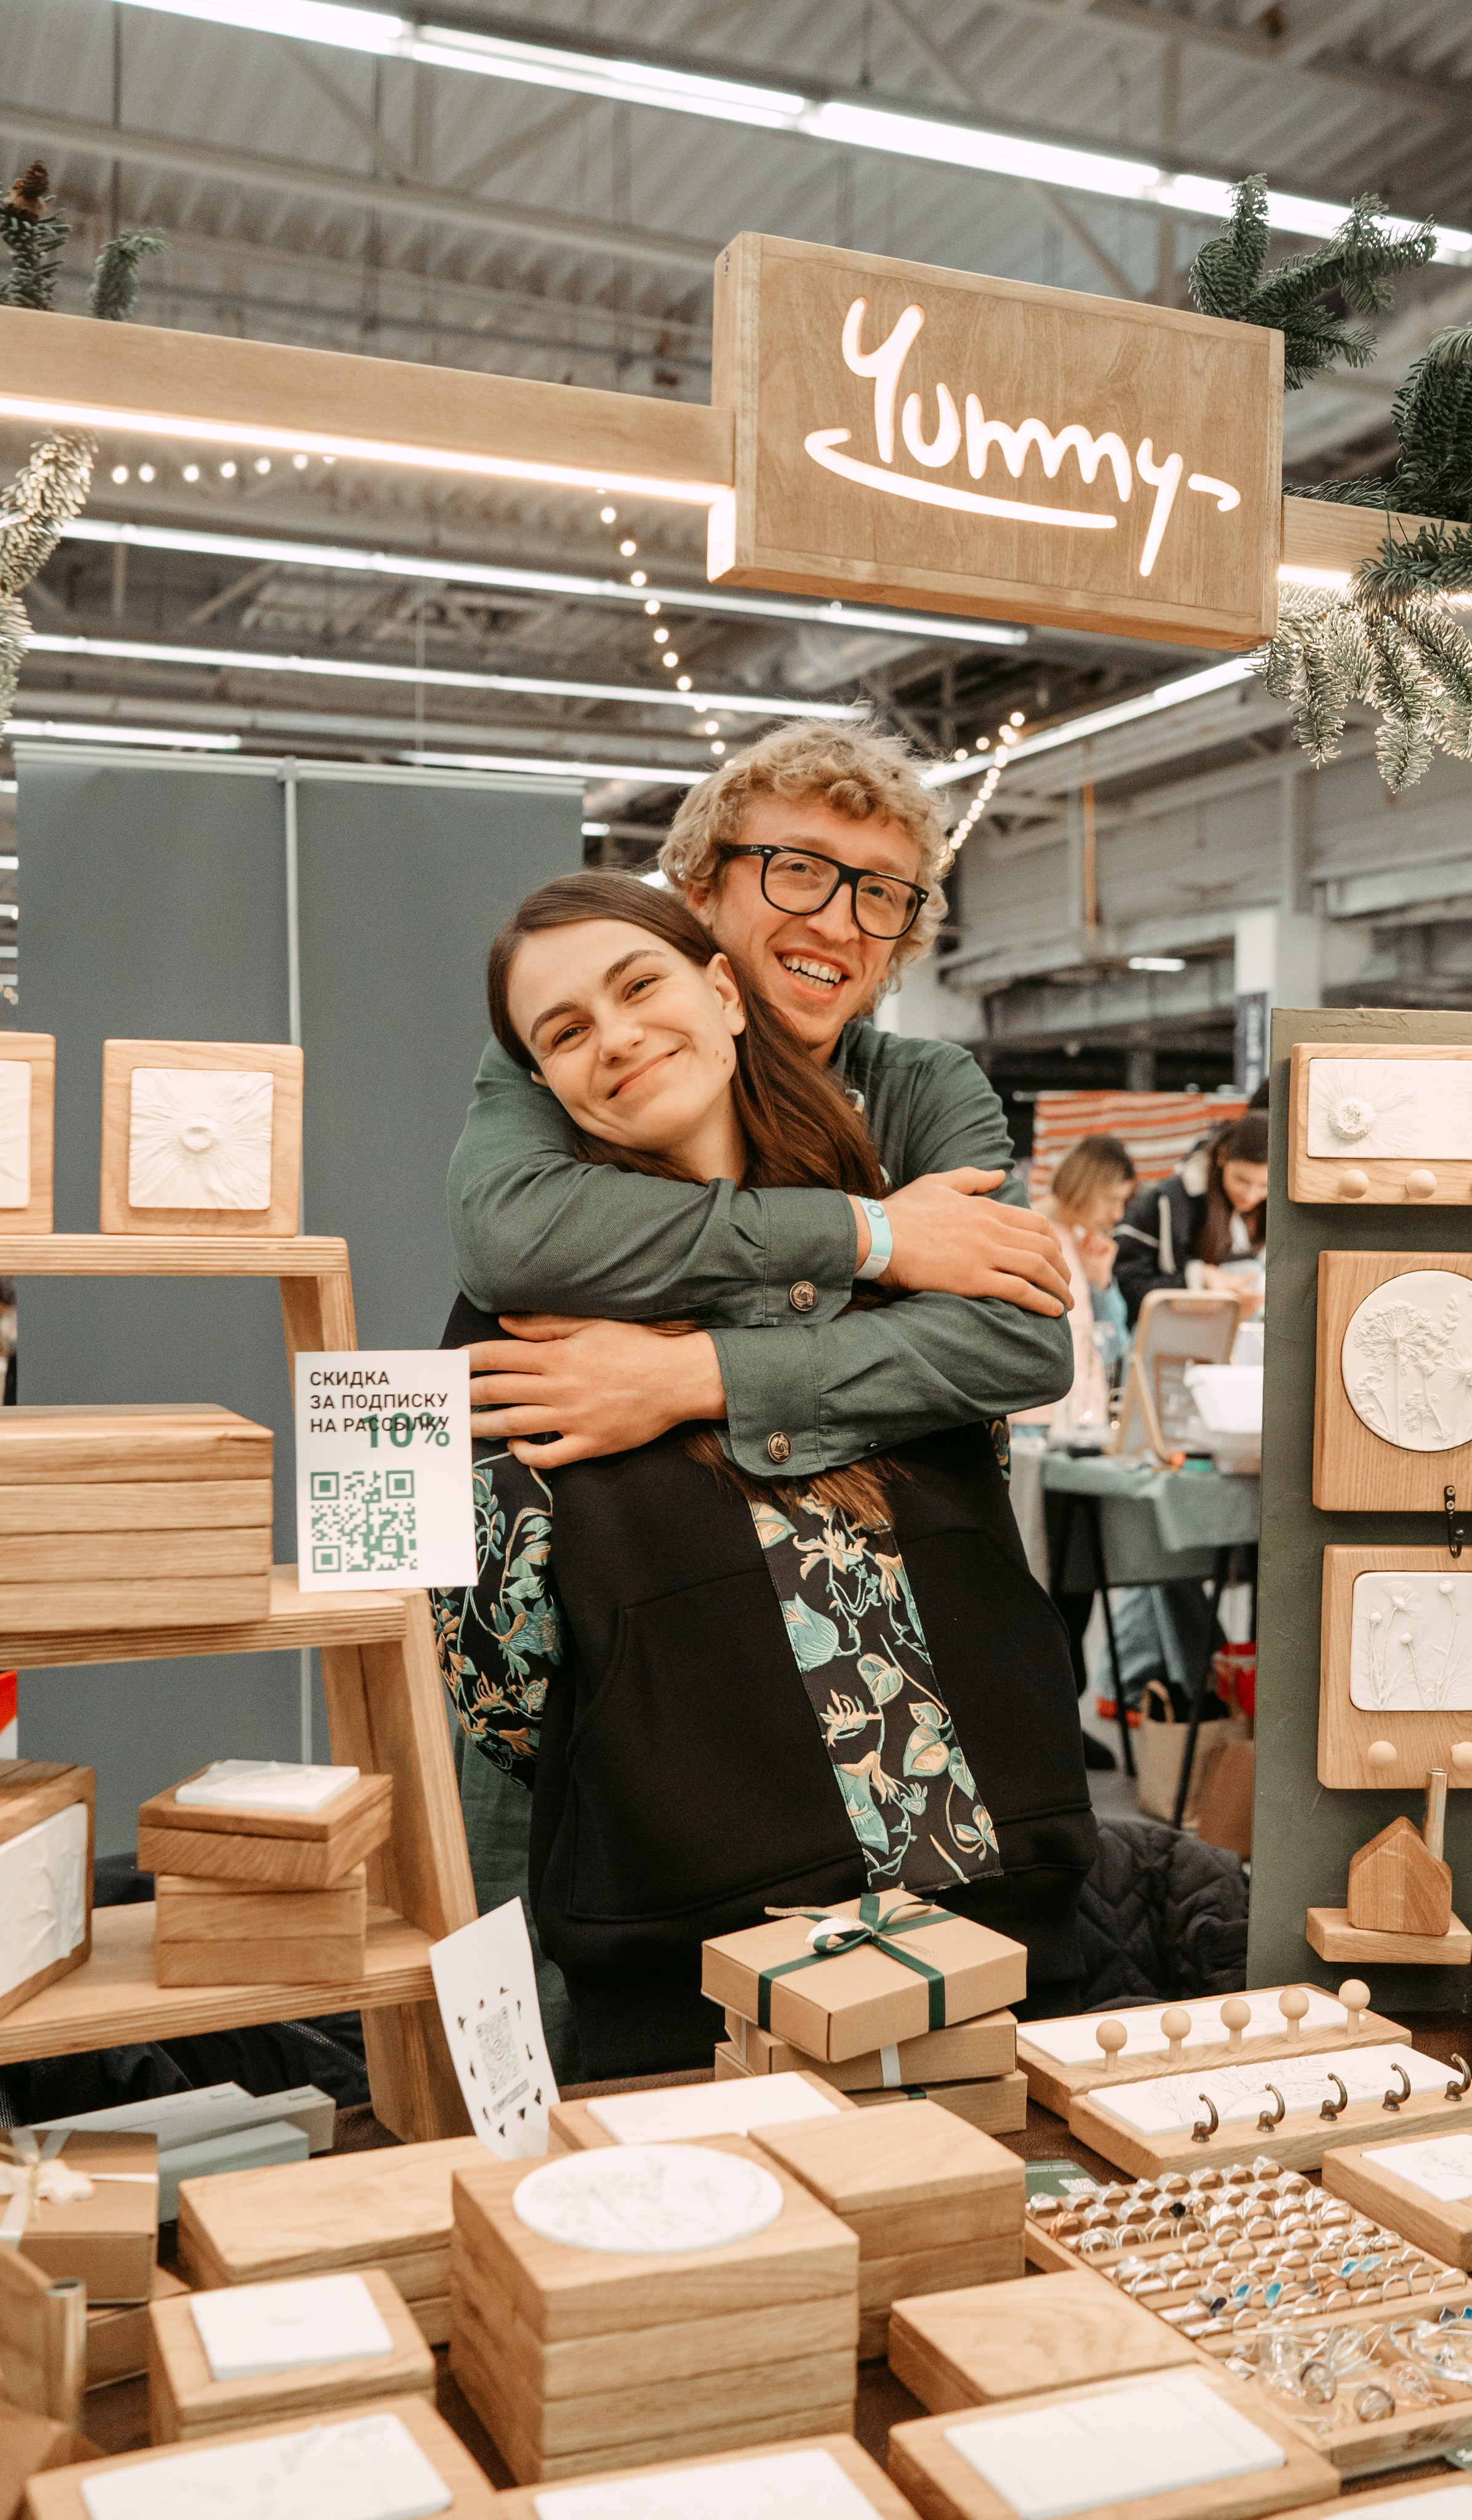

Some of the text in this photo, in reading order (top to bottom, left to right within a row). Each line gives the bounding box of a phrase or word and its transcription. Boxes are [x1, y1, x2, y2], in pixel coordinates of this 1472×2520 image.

[841, 297, 1183, 577] Yummy
[310, 1371, 390, 1389] СКИДКА
[310, 1393, 448, 1411] ЗА ПОДПИСКУ
[311, 1416, 450, 1433] НА РАССЫЛКУ
[362, 1412, 450, 1448] 10%
